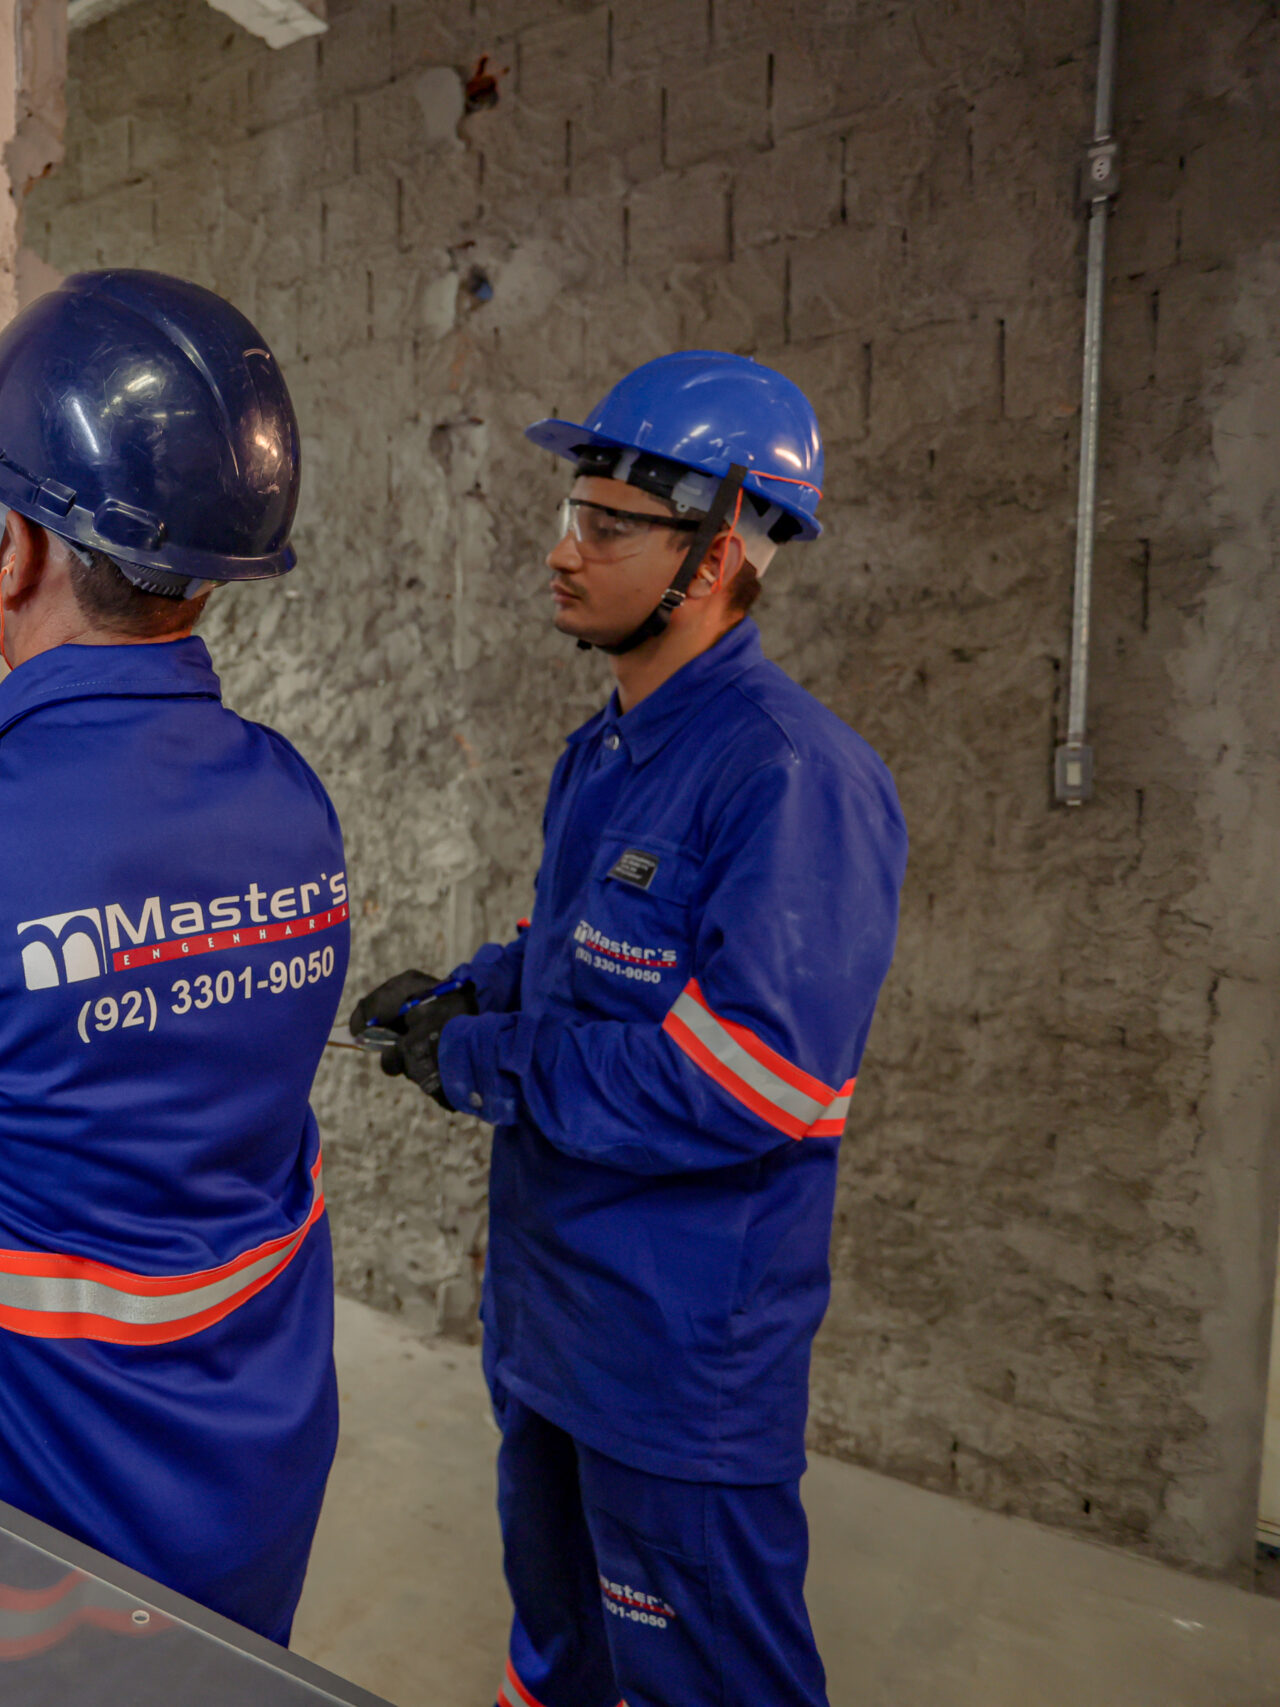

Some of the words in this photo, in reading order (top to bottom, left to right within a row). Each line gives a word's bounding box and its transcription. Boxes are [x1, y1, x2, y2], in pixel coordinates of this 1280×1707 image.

[105, 872, 347, 949] Master's
[124, 907, 346, 966] ENGENHARIA
[587, 930, 677, 962] Master's
[593, 956, 661, 984] 3301-9050
[77, 987, 158, 1043] (92)
[171, 946, 335, 1015] 3301-9050
